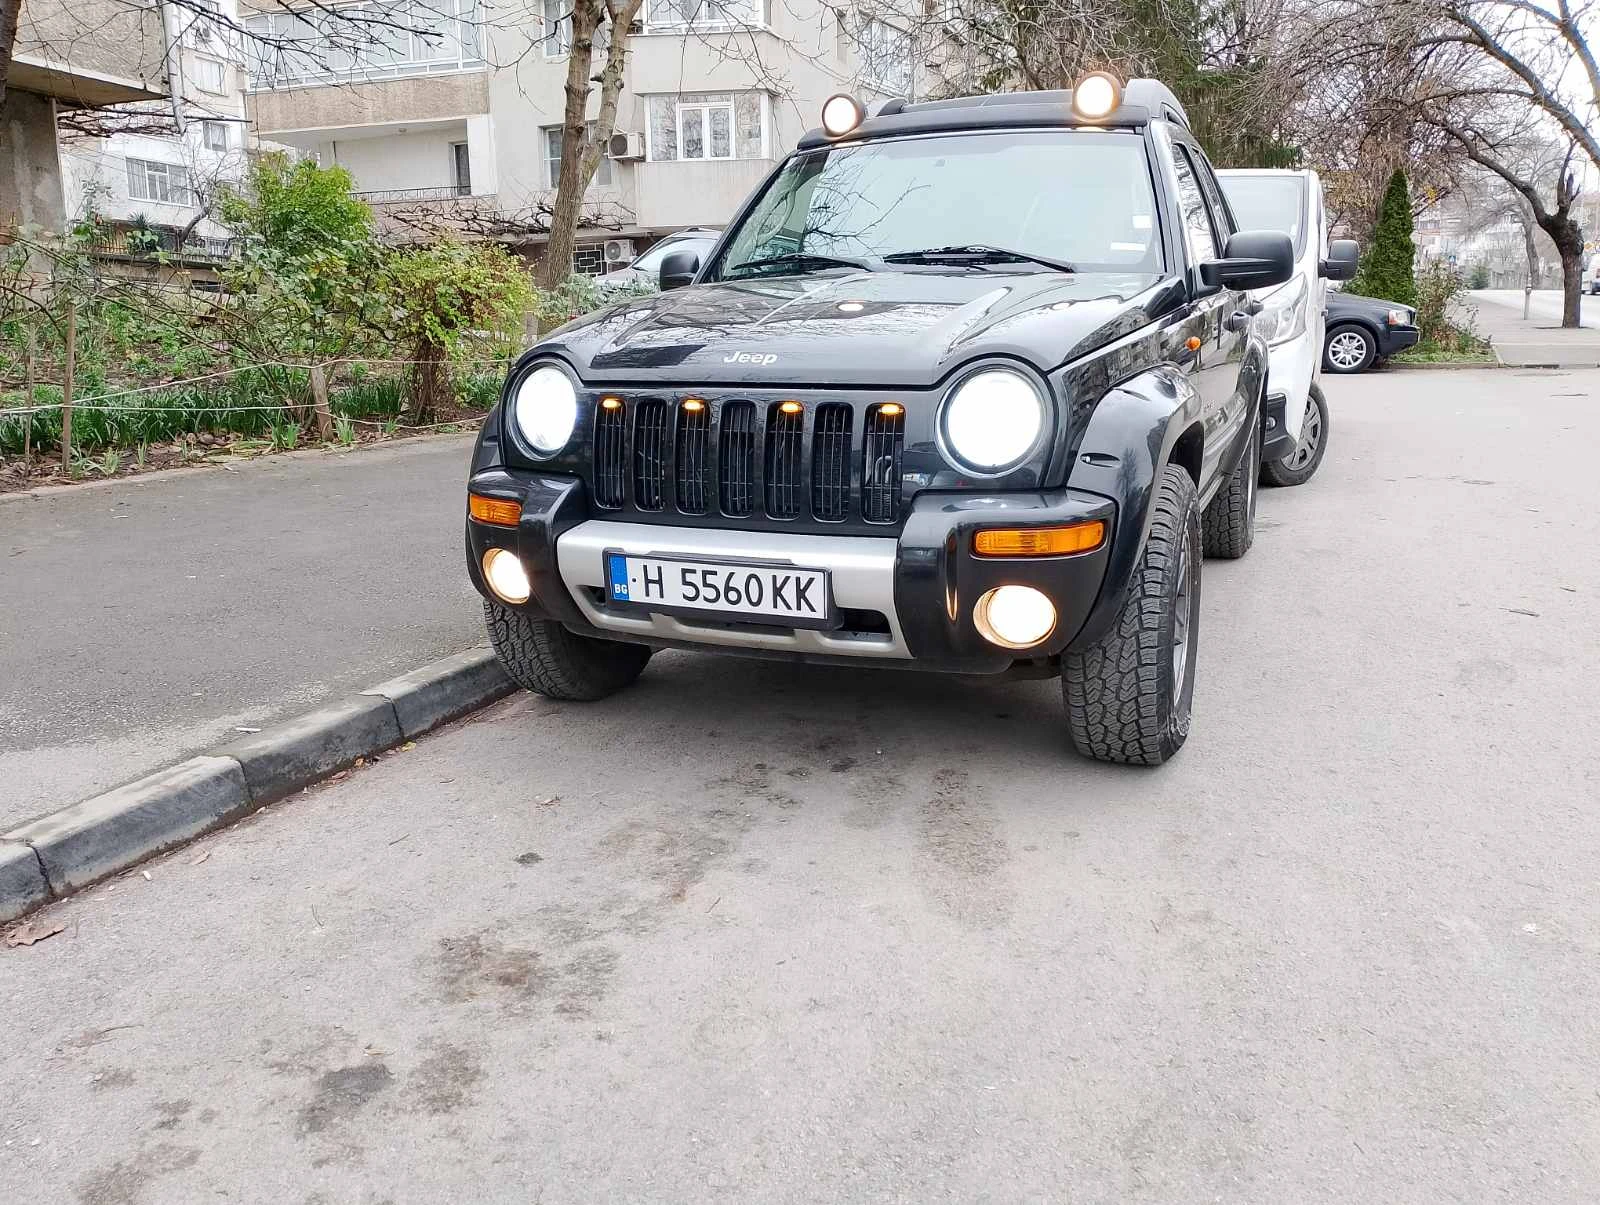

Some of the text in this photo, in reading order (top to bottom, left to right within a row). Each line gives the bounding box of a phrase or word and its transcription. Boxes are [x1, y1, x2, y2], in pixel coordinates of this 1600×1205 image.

[723, 351, 777, 366] Jeep
[614, 583, 628, 595] BG
[643, 564, 817, 613] H 5560 KK
